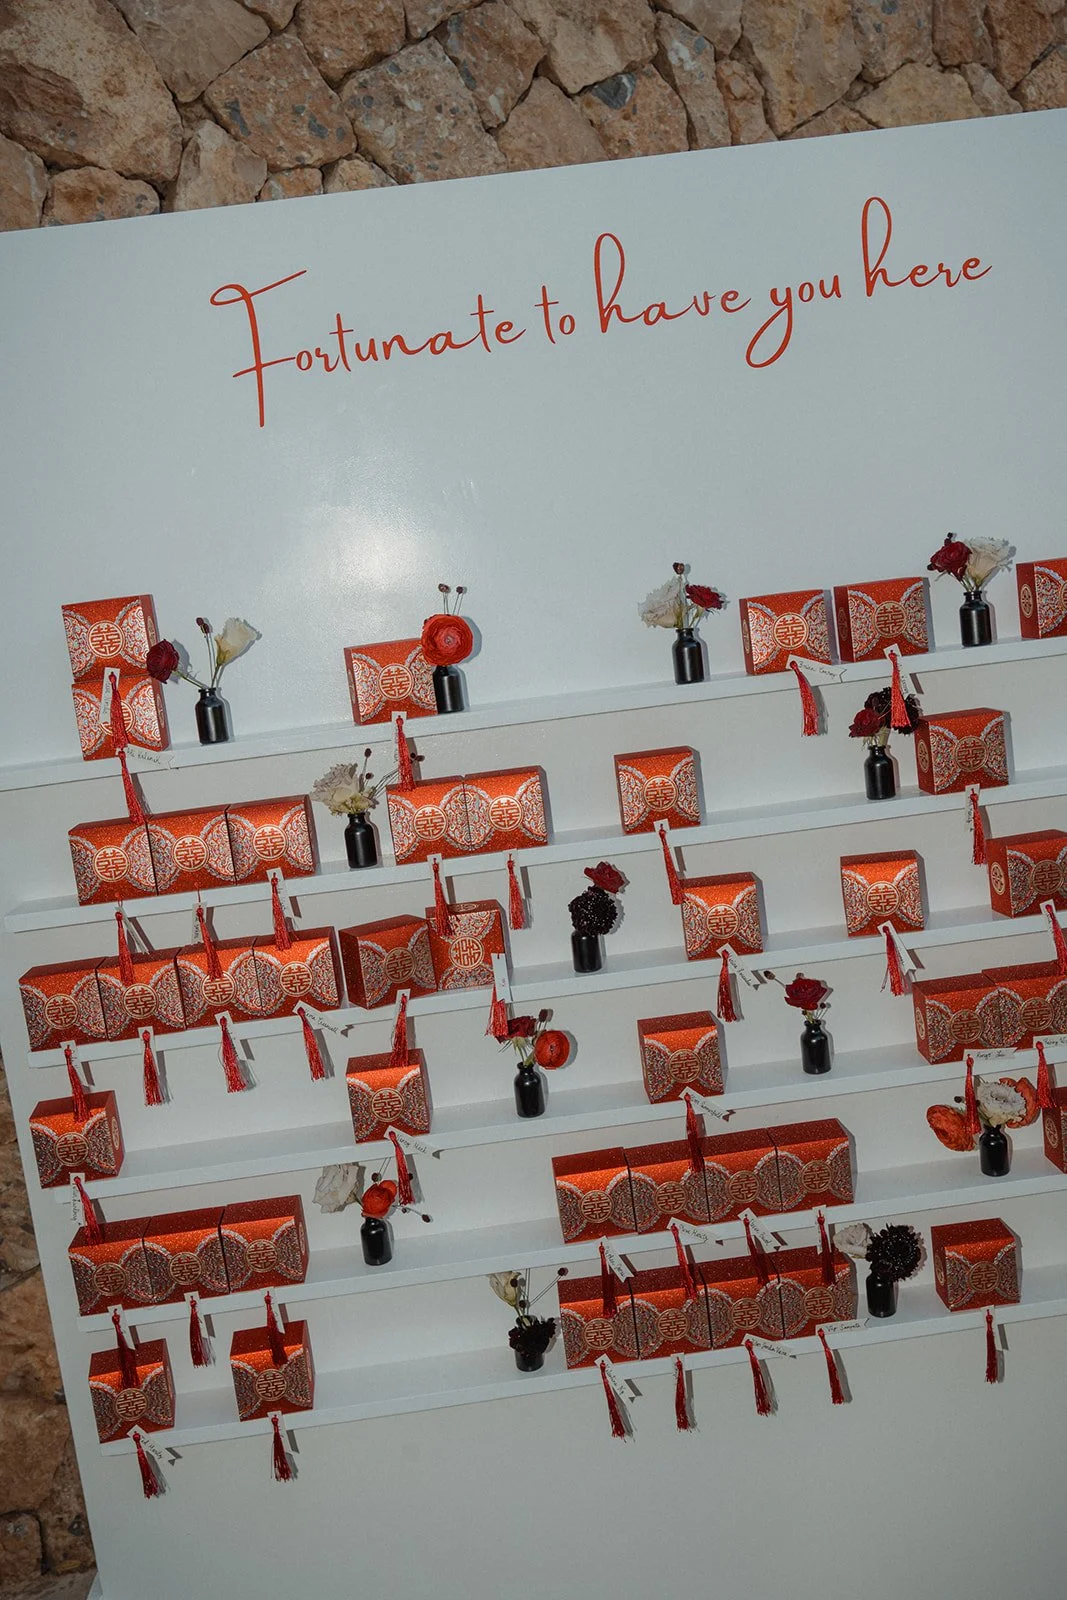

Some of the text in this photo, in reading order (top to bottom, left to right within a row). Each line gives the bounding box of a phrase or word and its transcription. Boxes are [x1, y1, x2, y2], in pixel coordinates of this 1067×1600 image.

[209, 196, 993, 428] Fortunate to have you here
